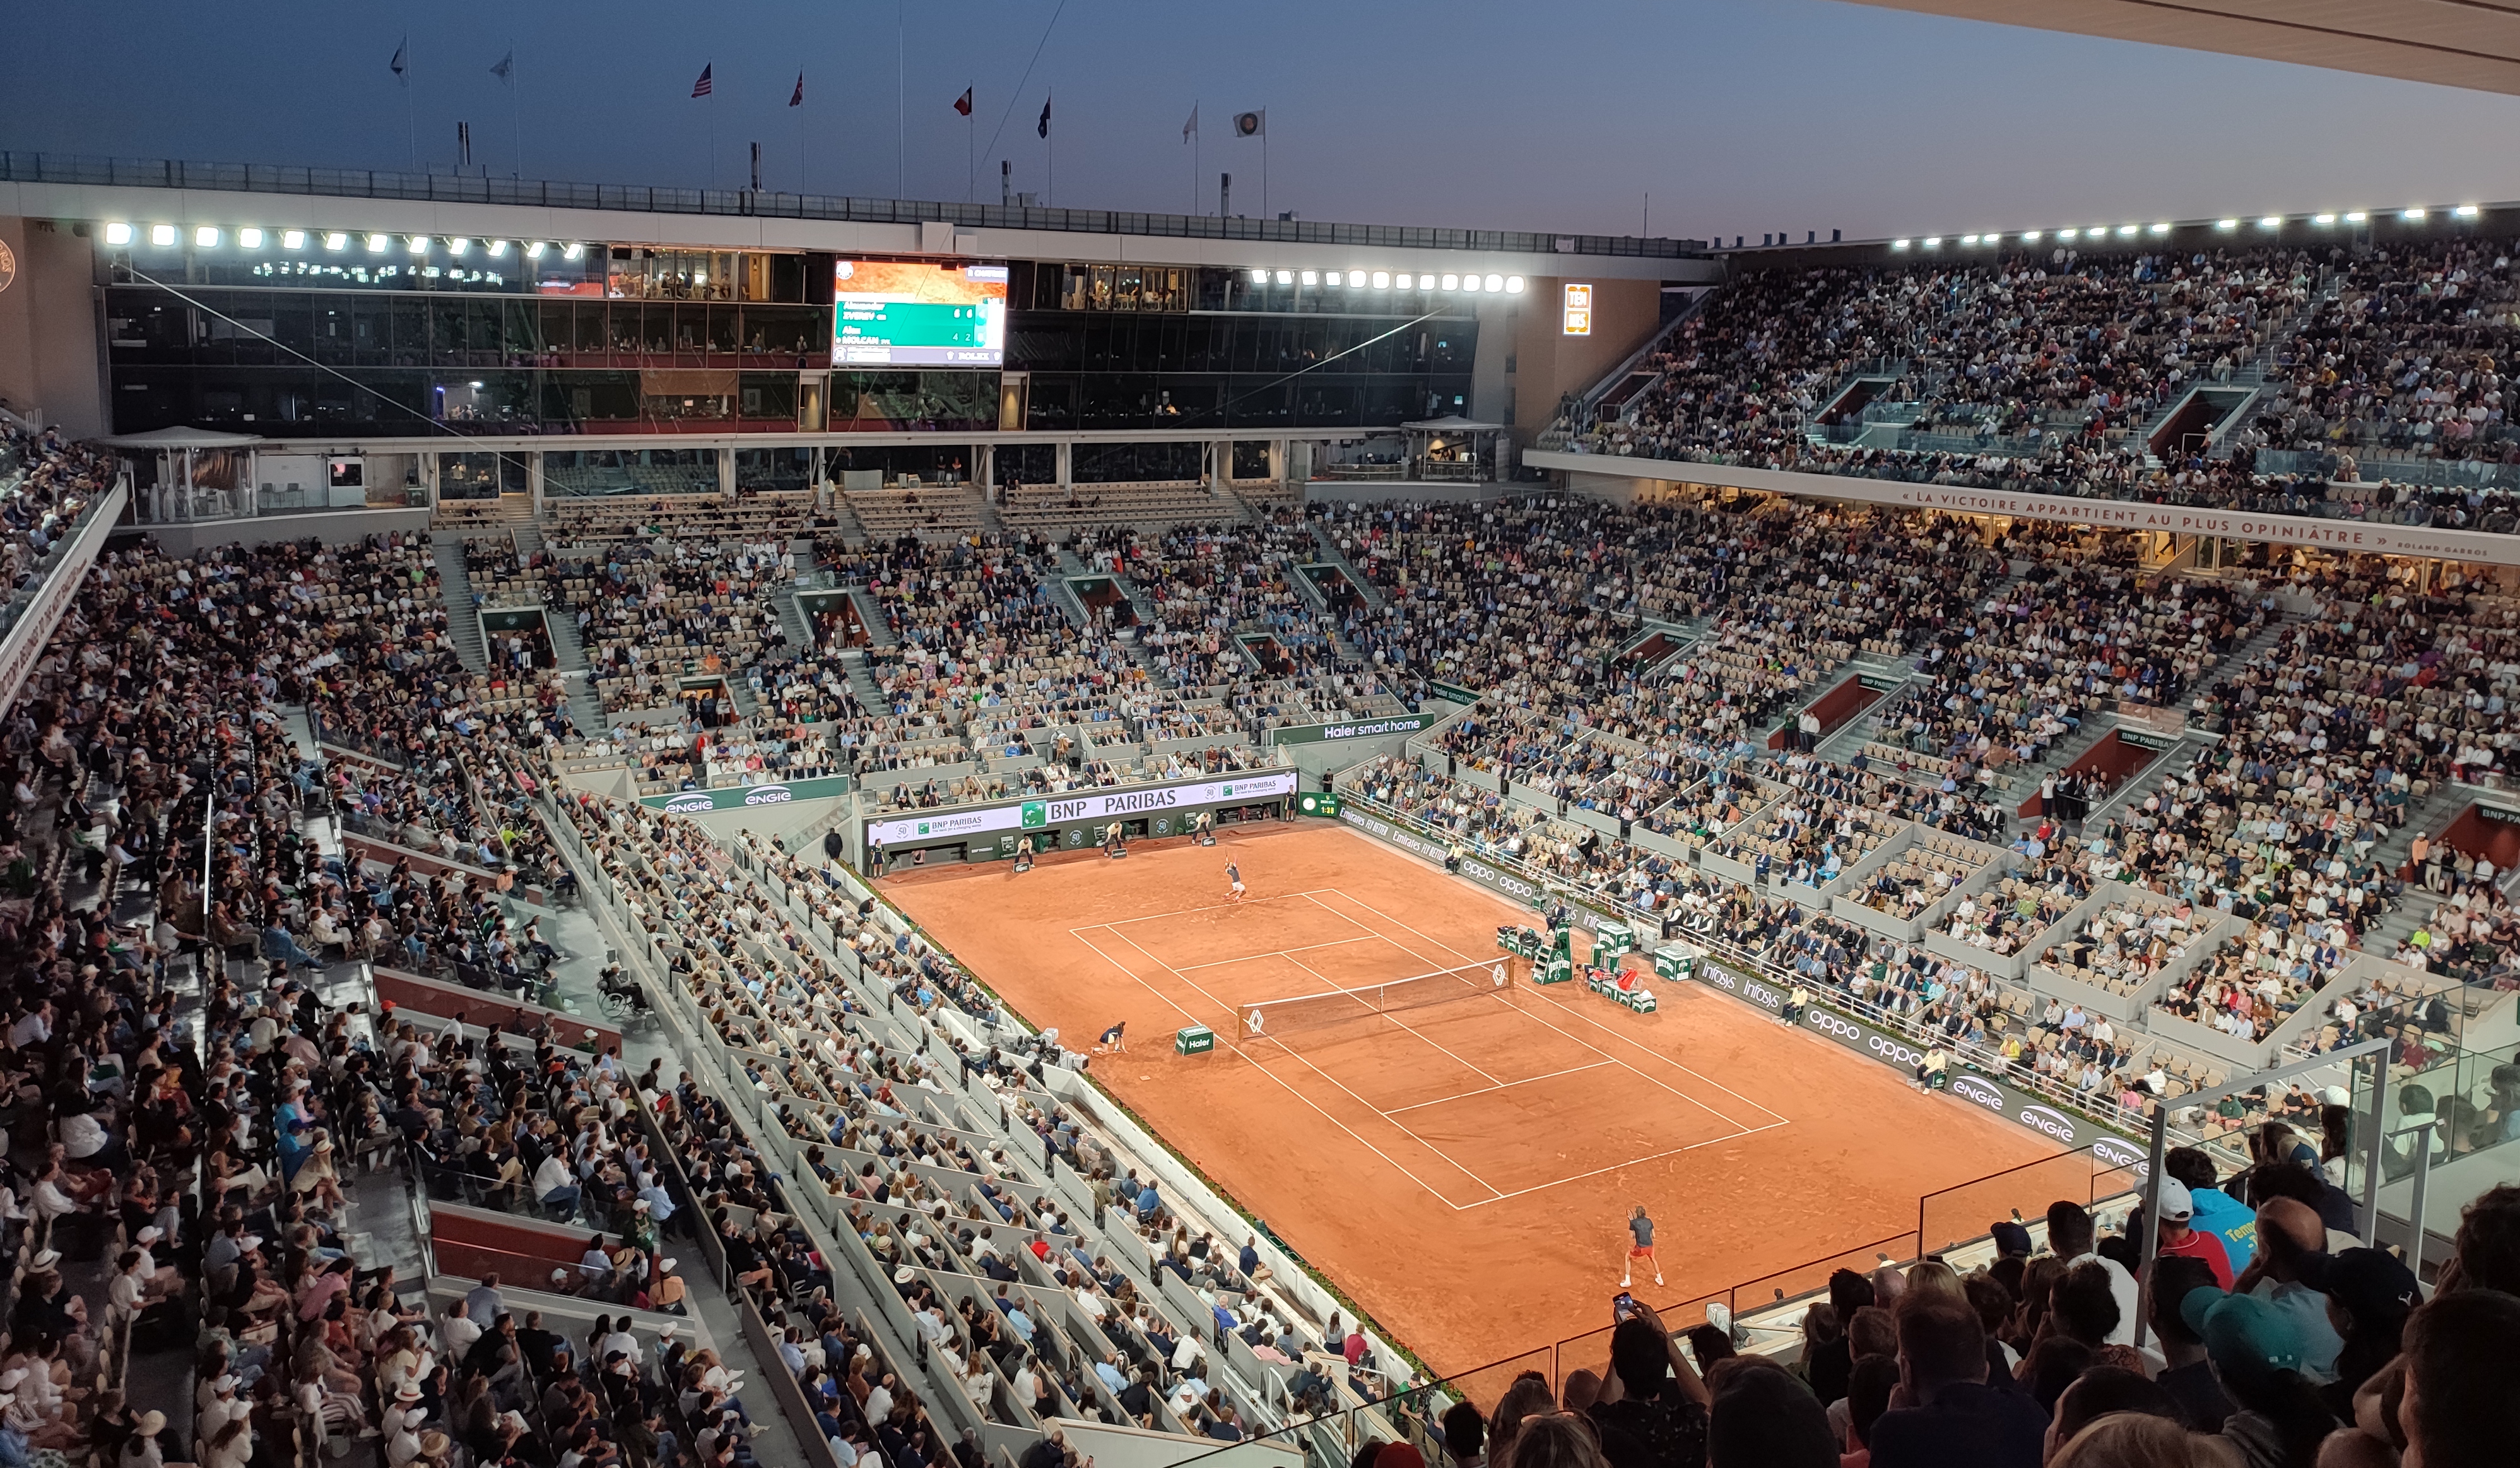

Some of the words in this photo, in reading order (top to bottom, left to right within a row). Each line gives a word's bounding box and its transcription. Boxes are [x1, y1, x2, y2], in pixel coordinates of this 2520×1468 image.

[952, 333, 958, 341] 4
[965, 333, 971, 341] 2
[958, 352, 990, 361] ROLEX
[1916, 491, 1933, 503] LA
[1941, 494, 2017, 511] VICTOIRE
[2025, 502, 2138, 523] APPARTIENT
[2146, 514, 2170, 525] AU
[2182, 516, 2230, 531] PLUS
[2241, 522, 2364, 544] OPINIÂTRE
[2398, 542, 2440, 552] ROLAND
[2444, 546, 2488, 557] GARROS
[1432, 685, 1448, 697] Haier
[1448, 691, 1464, 702] smart
[1324, 724, 1356, 739] Haier
[1357, 720, 1389, 735] smart
[1390, 719, 1420, 733] home
[2121, 732, 2139, 741] BNP
[1249, 780, 1276, 790] PARIBAS
[1051, 801, 1087, 820] BNP
[1105, 790, 1176, 814] PARIBAS
[2482, 808, 2506, 820] BNP
[932, 820, 948, 829] BNP
[950, 816, 982, 827] PARIBAS
[1339, 807, 1365, 827] Emirates
[1365, 818, 1373, 831] FLY
[1372, 821, 1389, 837] BETTER
[1392, 830, 1422, 851] Emirates
[1420, 843, 1431, 855] FLY
[1429, 846, 1447, 863] BETTER
[1463, 860, 1495, 881] oppo
[1499, 876, 1533, 898] oppo
[1582, 915, 1598, 930] Info
[1702, 962, 1736, 990] Infosys
[1742, 978, 1781, 1009] Infosys
[1809, 1009, 1861, 1041] oppo
[1189, 1038, 1210, 1049] Haier
[1868, 1035, 1923, 1068] oppo
